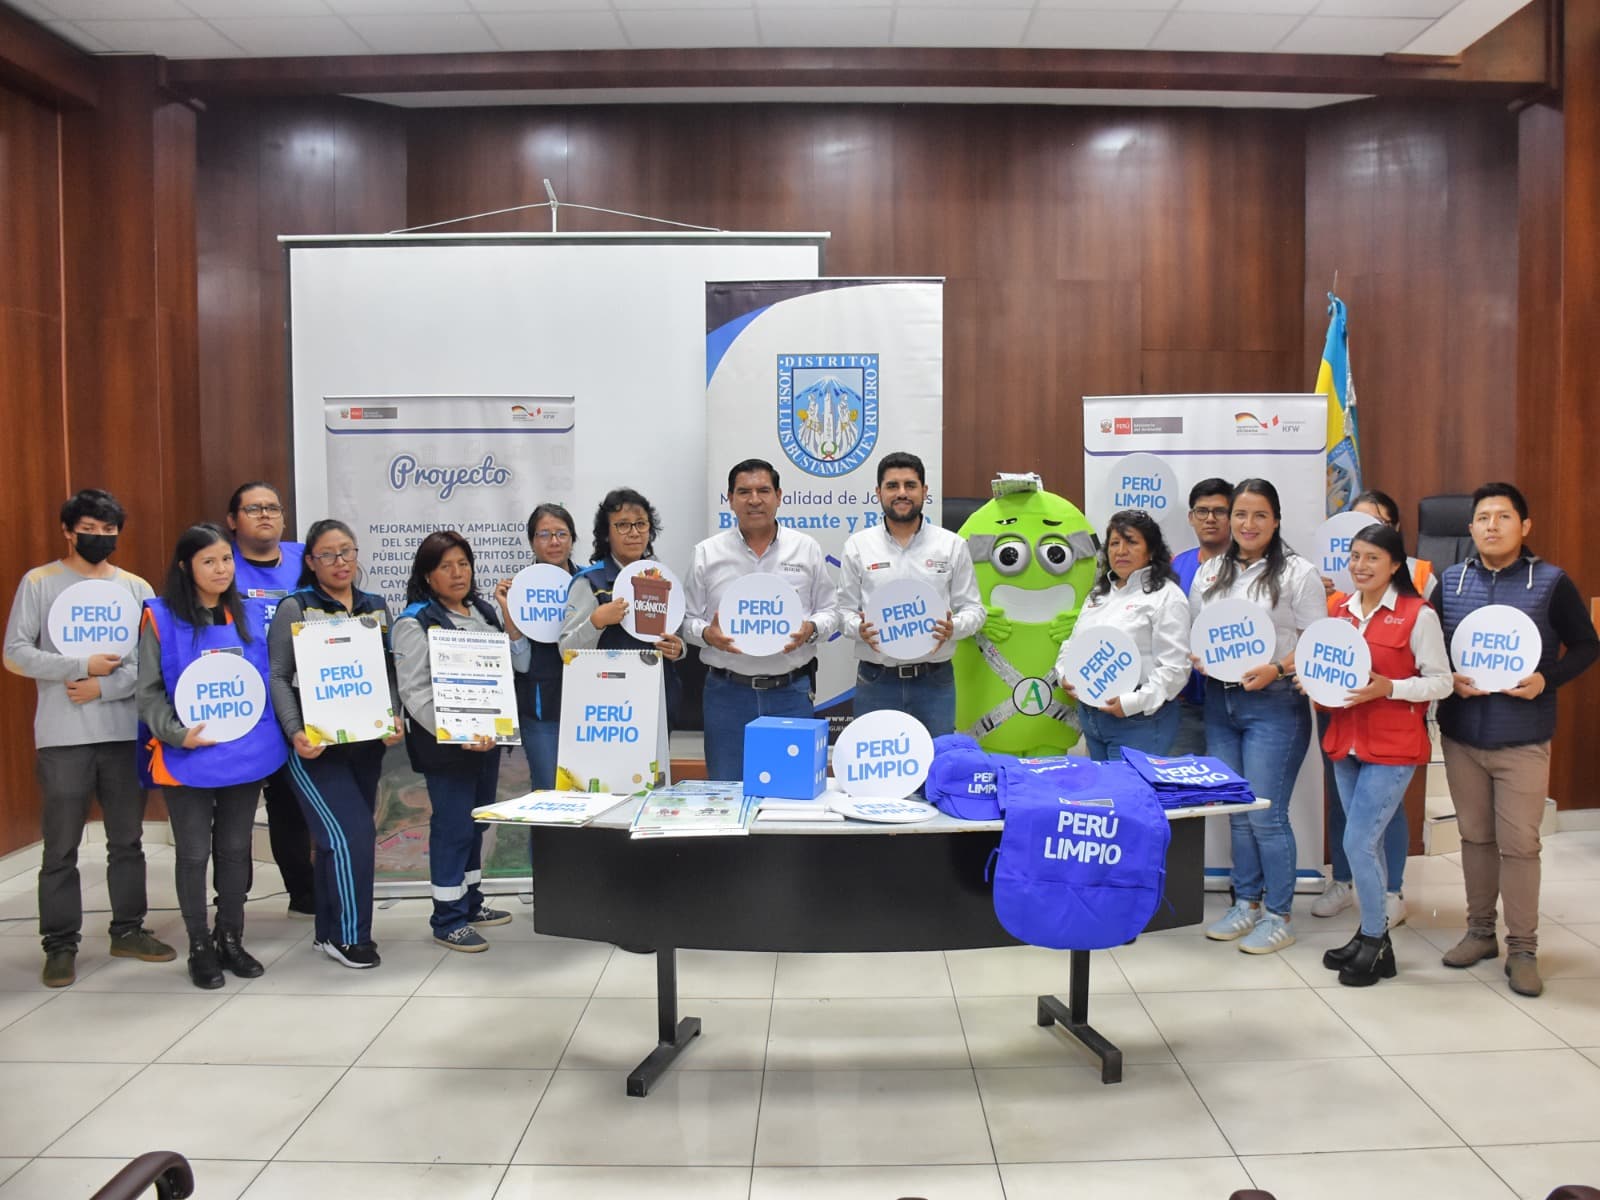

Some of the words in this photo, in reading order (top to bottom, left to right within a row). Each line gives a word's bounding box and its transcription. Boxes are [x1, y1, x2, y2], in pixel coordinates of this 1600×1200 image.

[785, 356, 871, 367] DISTRITO
[779, 369, 791, 406] JOSE
[864, 368, 877, 426] RIVERO
[779, 409, 794, 443] LUIS
[785, 439, 873, 474] BUSTAMANTE
[390, 455, 511, 499] Proyecto
[1122, 473, 1161, 491] PERÚ
[721, 491, 832, 505] Malidad
[838, 491, 857, 505] de
[1115, 493, 1166, 509] LIMPIO
[370, 524, 455, 534] MEJORAMIENTO
[458, 524, 465, 532] Y
[846, 516, 859, 533] y
[382, 538, 401, 547] DEL
[474, 538, 522, 546] LIMPIEZA
[1330, 538, 1351, 552] PE
[474, 551, 514, 560] STRITOS
[518, 552, 532, 560] DE
[1324, 557, 1349, 572] LIM
[370, 566, 411, 575] AREQUI
[493, 565, 527, 574] ALEGR
[526, 585, 568, 604] PERÚ
[738, 595, 783, 616] PERÚ
[71, 601, 121, 622] PERÚ
[882, 595, 926, 623] PERÚ
[62, 626, 128, 642] LIMPIO
[730, 619, 790, 635] LIMPIO
[879, 617, 937, 644] LIMPIO
[1208, 615, 1254, 644] PERÚ
[1205, 638, 1266, 664] LIMPIO
[1471, 630, 1520, 651] PERÚ
[1079, 640, 1116, 681] PERÚ
[1313, 641, 1355, 667] PERÚ
[1460, 650, 1524, 672] LIMPIO
[320, 659, 364, 682] PERÚ
[1086, 651, 1132, 700] LIMPIO
[1304, 661, 1357, 689] LIMPIO
[196, 674, 244, 700] PERÚ
[315, 681, 372, 701] LIMPIO
[190, 700, 254, 722] LIMPIO
[585, 700, 633, 722] PERÚ
[576, 725, 639, 744] LIMPIO
[856, 732, 910, 759] PERÚ
[847, 759, 919, 782] LIMPIO
[1057, 810, 1118, 838] PERÚ
[1044, 836, 1122, 864] LIMPIO
